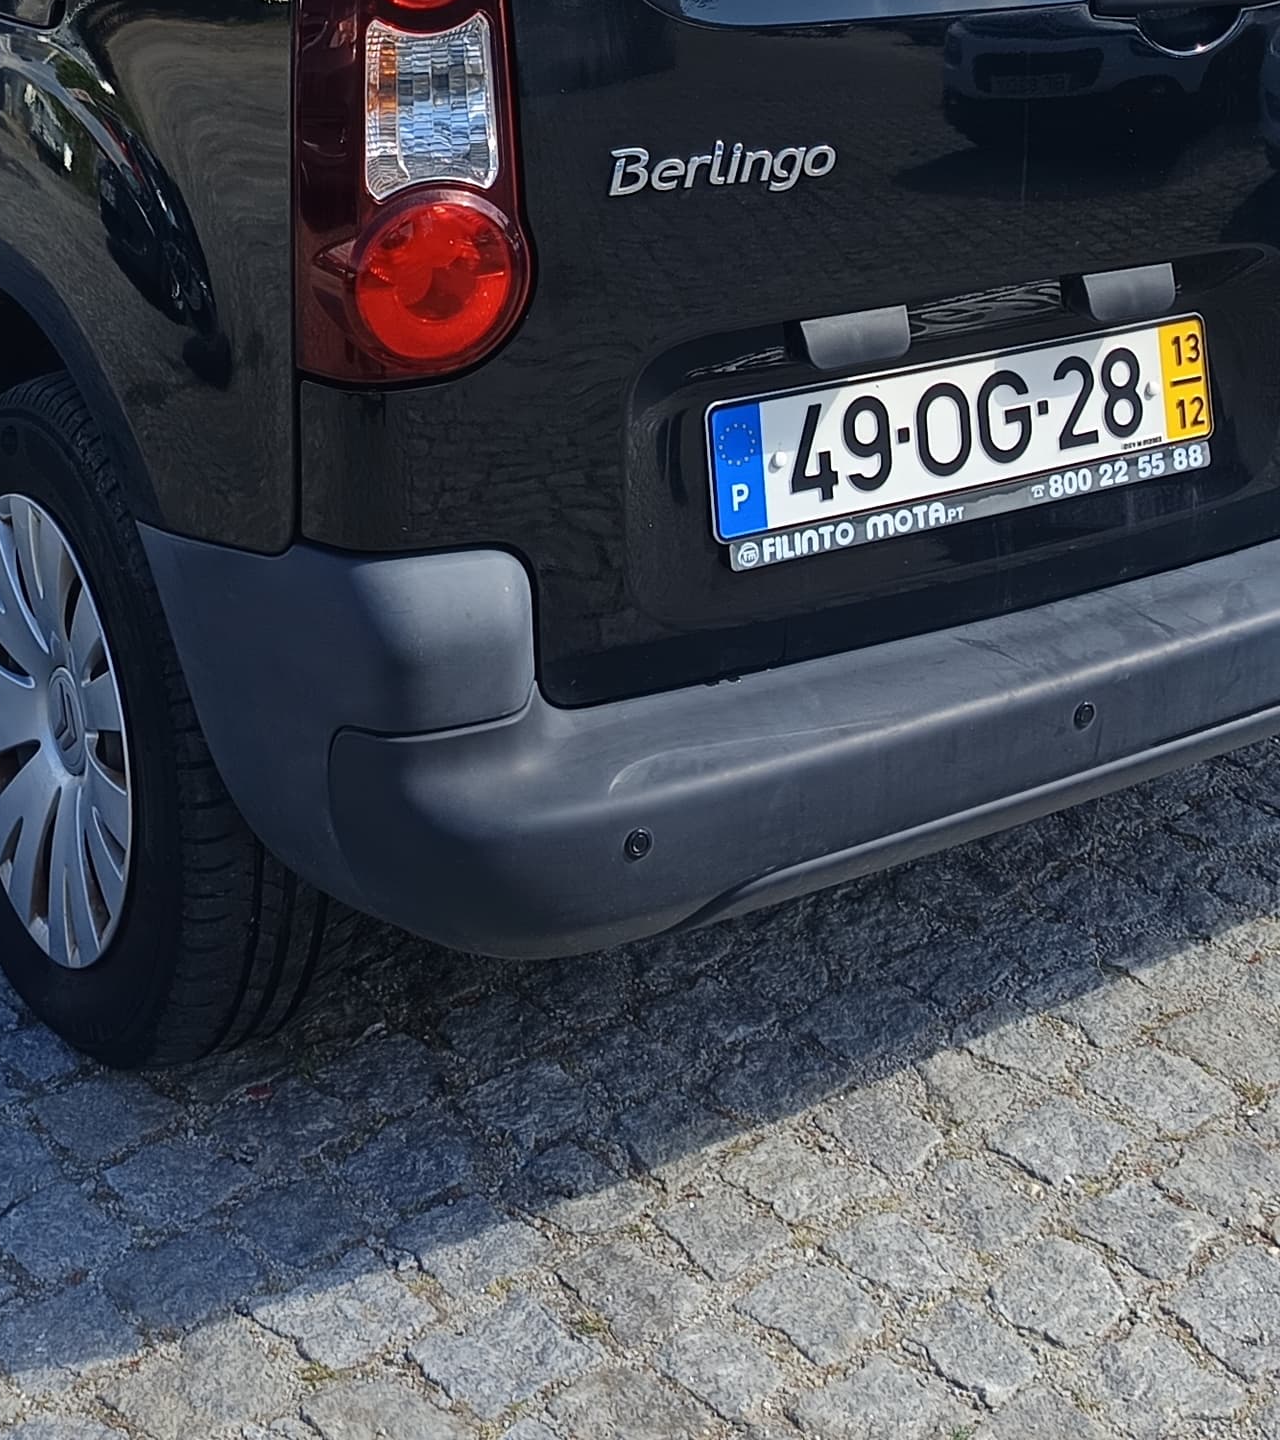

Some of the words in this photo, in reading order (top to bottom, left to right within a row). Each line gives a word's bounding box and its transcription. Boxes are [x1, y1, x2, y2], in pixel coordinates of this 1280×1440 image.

[608, 139, 837, 197] Berlingo
[1170, 333, 1201, 367] 13
[1176, 395, 1206, 430] 12
[1048, 468, 1093, 498] 800
[1098, 460, 1129, 488] 22
[1137, 452, 1166, 478] 55
[1173, 444, 1204, 470] 88
[731, 483, 750, 511] P
[762, 521, 856, 563] FILINTO
